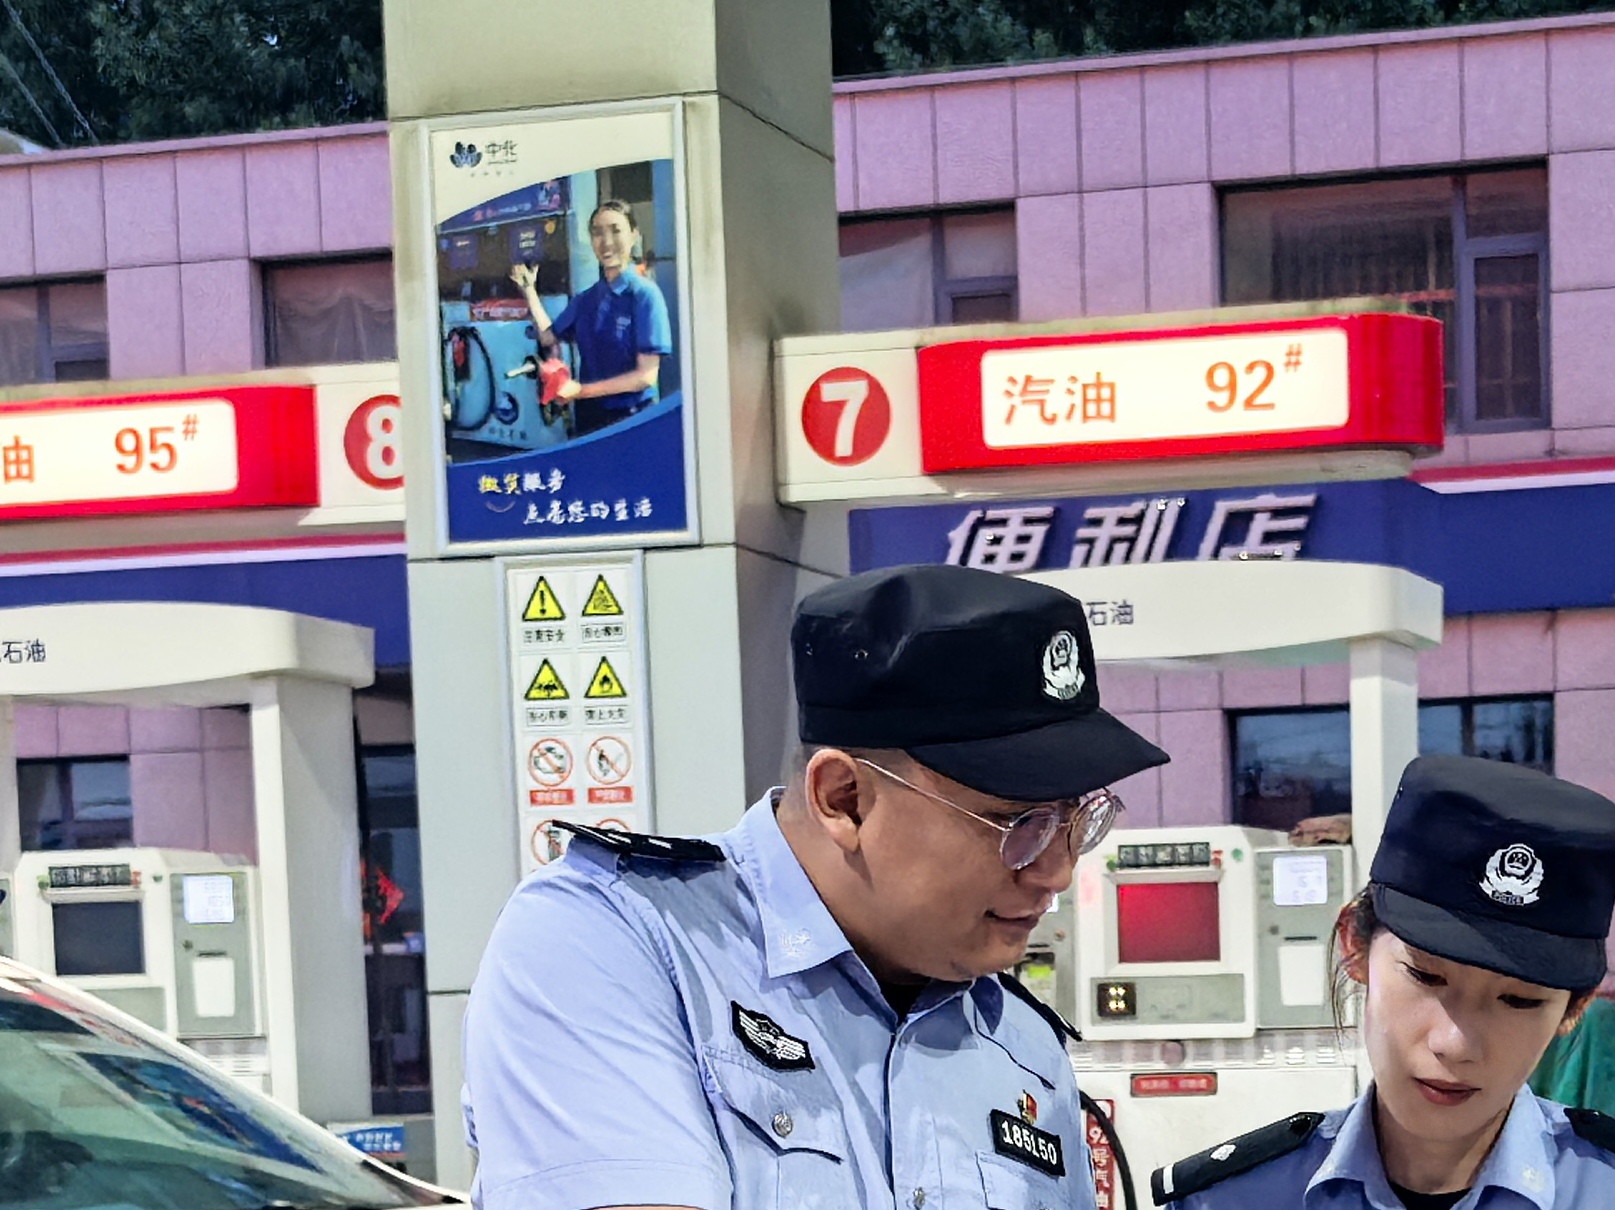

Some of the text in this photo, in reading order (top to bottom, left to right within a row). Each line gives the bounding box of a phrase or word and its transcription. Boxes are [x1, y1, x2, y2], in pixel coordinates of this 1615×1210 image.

[820, 380, 869, 457] 7
[1002, 372, 1117, 425] 汽油
[365, 405, 404, 479] 8
[946, 494, 1317, 575] 便利店
[1086, 599, 1134, 626] 石油
[0, 638, 46, 664] 石油
[1002, 1119, 1058, 1166] 185150
